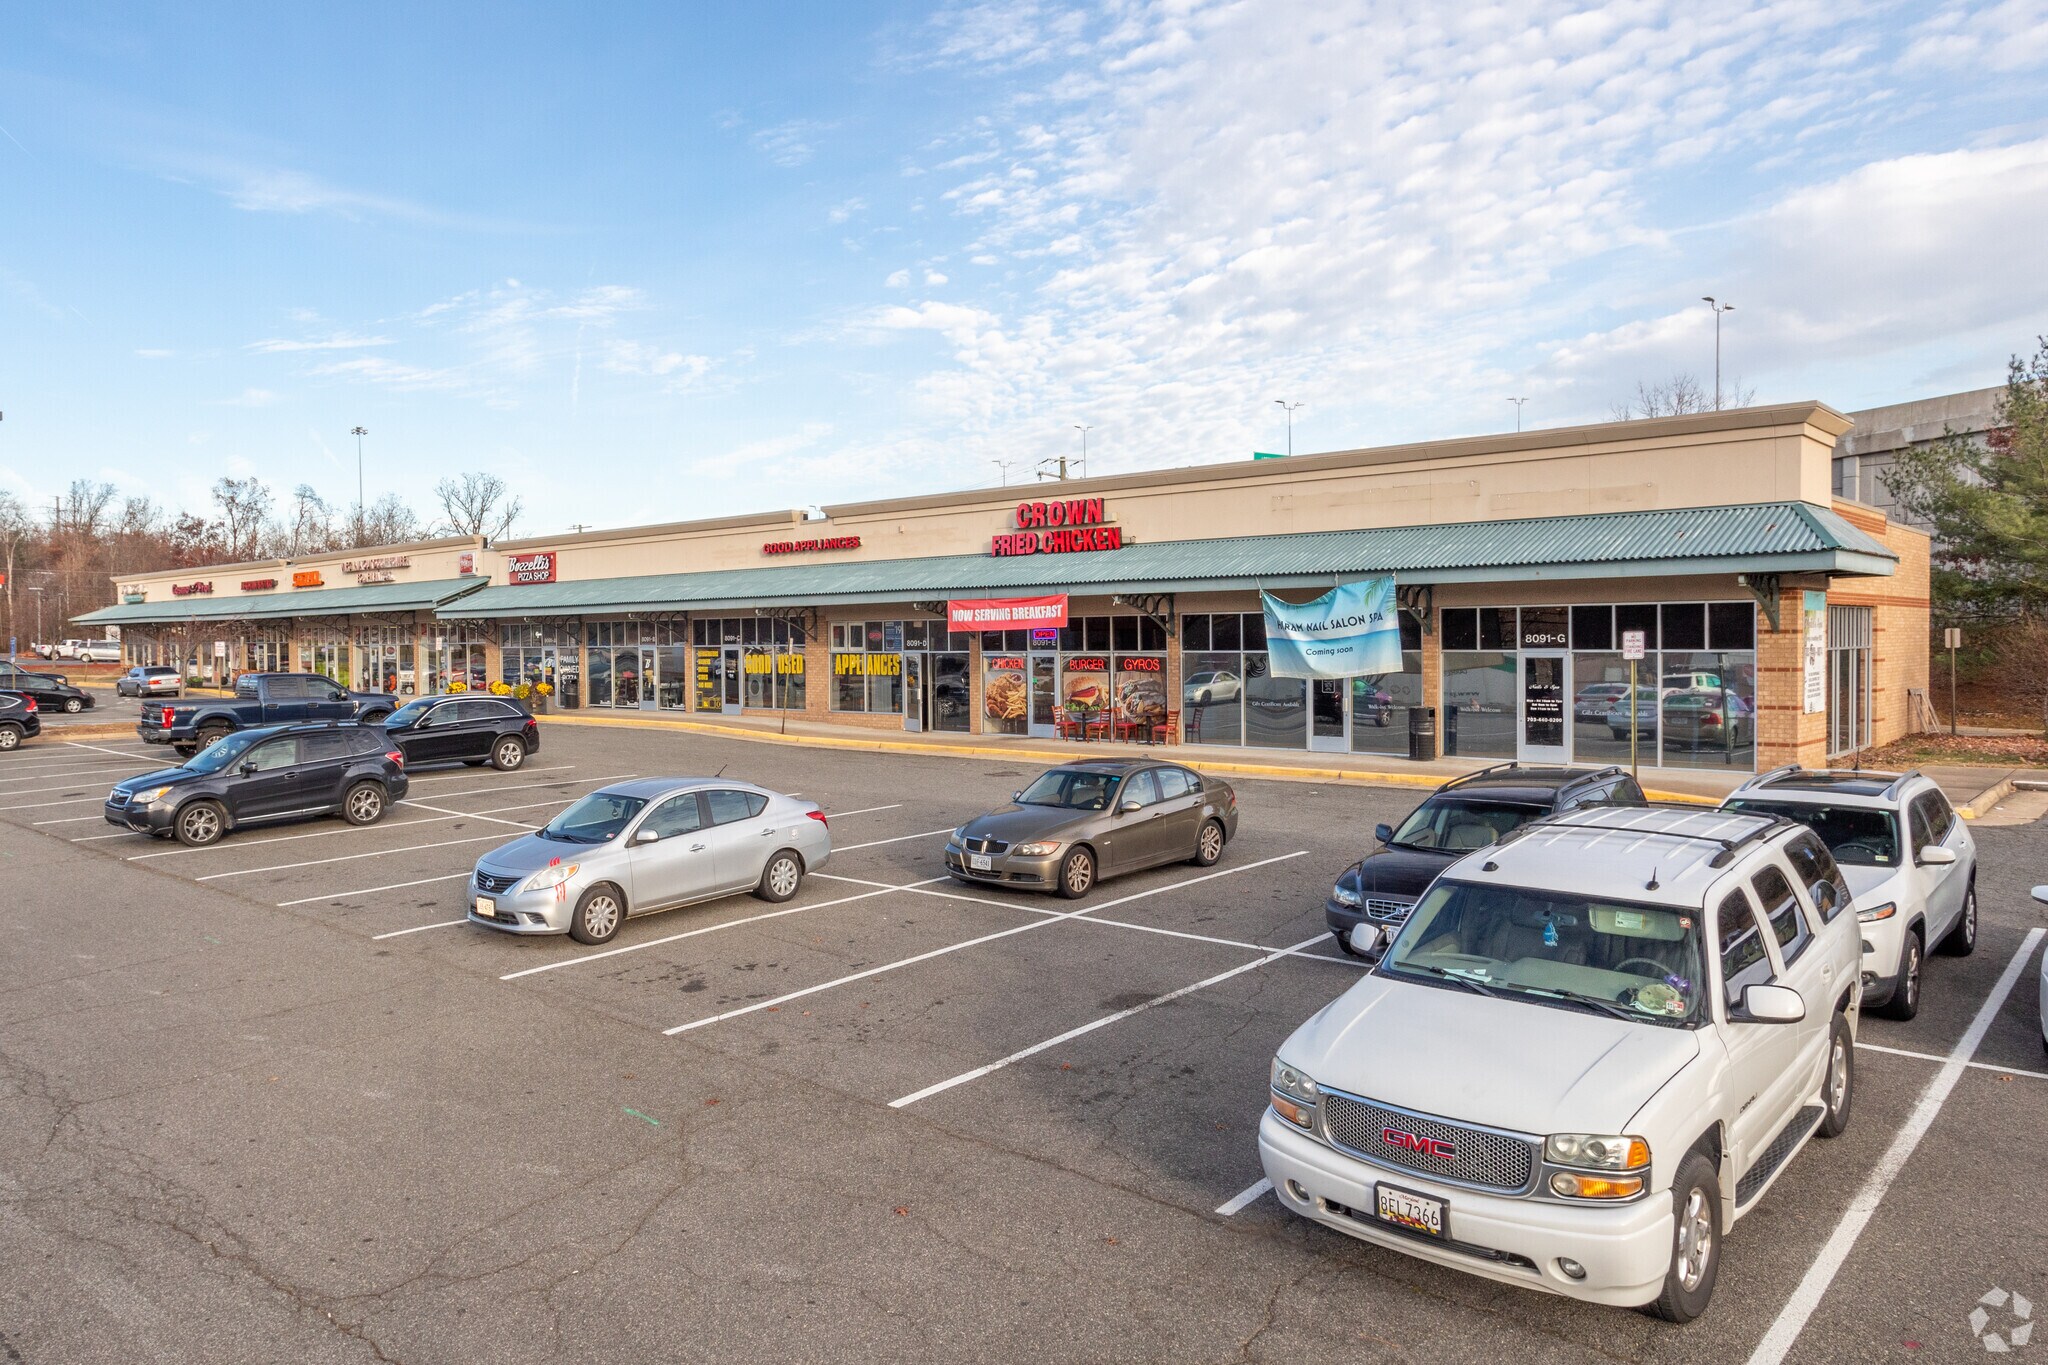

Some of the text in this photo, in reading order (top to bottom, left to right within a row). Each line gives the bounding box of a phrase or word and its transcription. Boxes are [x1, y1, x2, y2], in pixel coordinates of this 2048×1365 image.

[1016, 498, 1104, 529] CROWN
[763, 536, 860, 554] GOOD APPLIANCES
[992, 527, 1121, 557] FRIED CHICKEN
[509, 555, 549, 572] Bozzelli's
[518, 571, 549, 581] PIZZA SHOP
[952, 604, 1063, 622] NOW SERVING BREAKFAST
[1306, 620, 1328, 632] NAIL
[1330, 614, 1366, 629] SALON
[1369, 612, 1384, 623] SPA
[1525, 634, 1566, 643] 8091-G
[560, 655, 579, 663] FAMILY
[1306, 648, 1334, 656] Coming
[745, 654, 803, 674] GOOD USED
[835, 654, 900, 675] APPLIANCES
[992, 658, 1024, 669] CHICKEN
[1069, 659, 1105, 670] BURGER
[1124, 658, 1160, 671] GYROS
[1383, 1127, 1455, 1160] GMC
[1399, 1194, 1420, 1203] Maryland
[1380, 1196, 1439, 1226] 8EL7366
